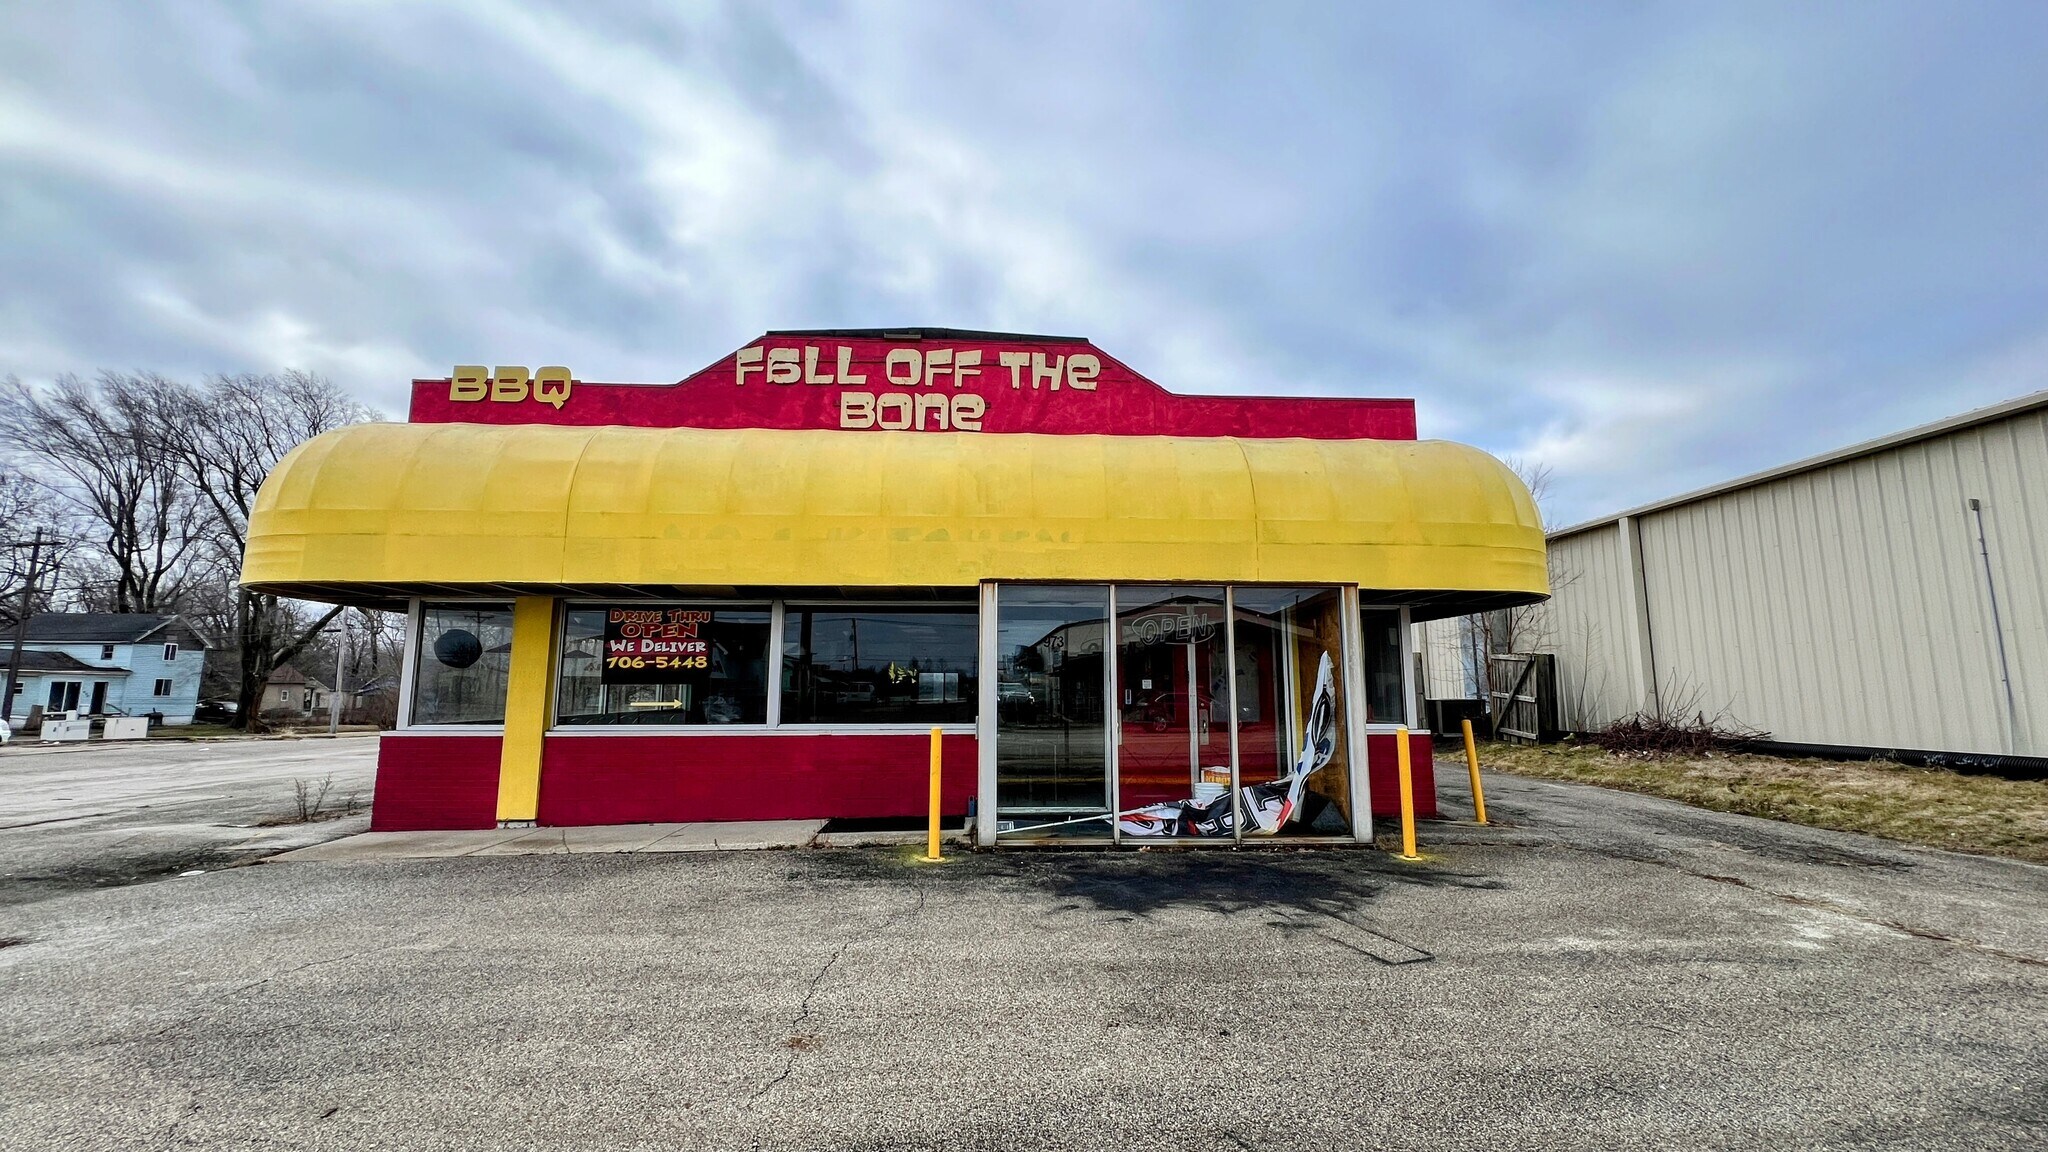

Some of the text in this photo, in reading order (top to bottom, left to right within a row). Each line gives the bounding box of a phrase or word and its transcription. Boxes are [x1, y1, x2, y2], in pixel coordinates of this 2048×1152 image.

[886, 349, 982, 387] OFF
[450, 365, 571, 410] BBQ
[610, 608, 711, 623] DRIVE THRU
[621, 623, 698, 638] OPEN
[1140, 614, 1207, 645] OPEN
[610, 639, 706, 652] WE DELIVER
[606, 656, 708, 669] 706-5448
